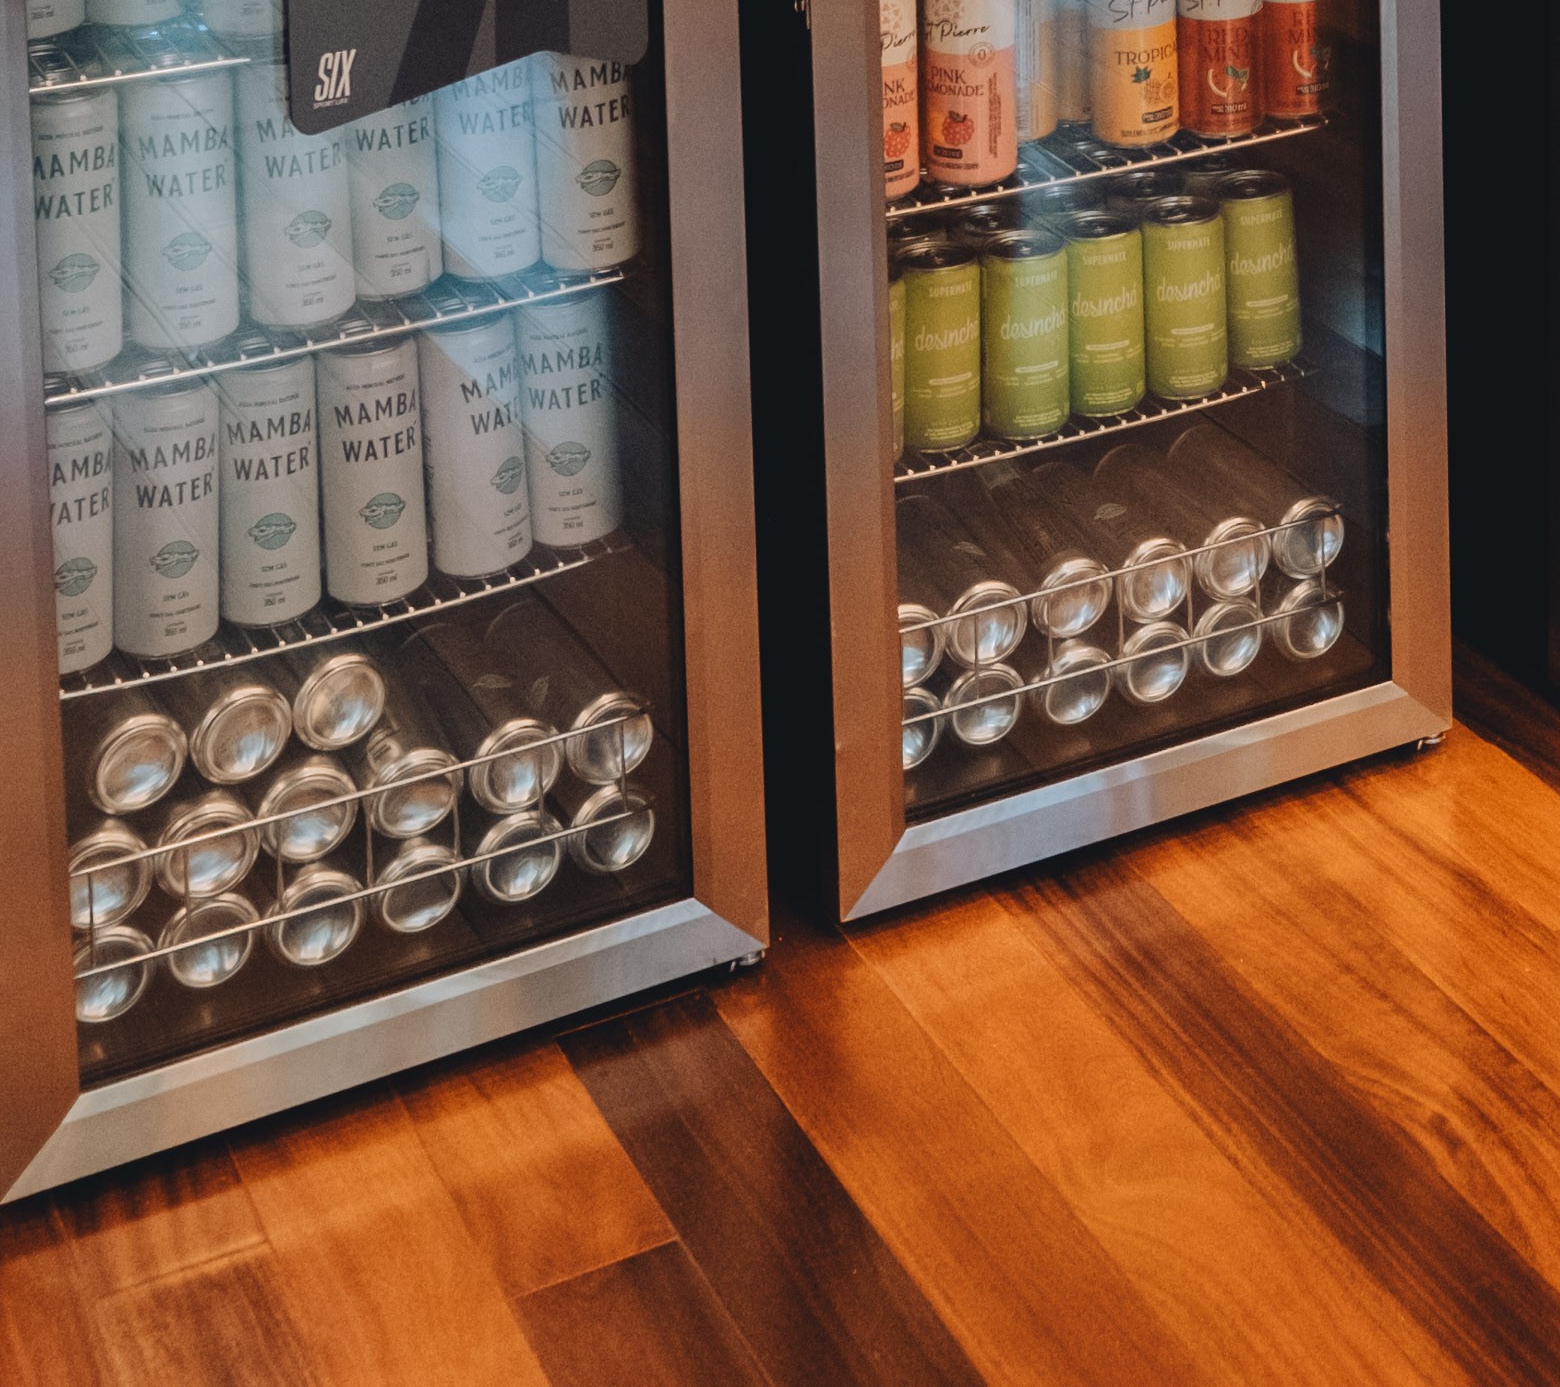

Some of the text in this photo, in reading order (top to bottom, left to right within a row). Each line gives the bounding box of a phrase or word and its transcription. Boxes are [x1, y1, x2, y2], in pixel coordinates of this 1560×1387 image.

[938, 19, 992, 44] Pierre
[1115, 40, 1177, 67] TROPICA
[314, 48, 357, 102] SIX
[884, 78, 906, 94] NK
[931, 66, 966, 85] PINK
[458, 100, 532, 135] WATER
[558, 94, 632, 129] WATER
[138, 126, 230, 162] MAMBA
[355, 116, 431, 152] WATER
[264, 143, 342, 179] WATER
[145, 163, 229, 198] WATER
[34, 182, 116, 221] WATER
[521, 342, 604, 377] MAMBA
[333, 387, 418, 429] MAMBA
[527, 378, 603, 412] WATER
[226, 407, 313, 447] MAMBA
[342, 425, 417, 464] WATER
[51, 446, 114, 488] AMBA
[130, 431, 217, 474] MAMBA
[233, 445, 311, 482] WATER
[50, 485, 110, 526] ATER
[136, 470, 213, 510] WATER
